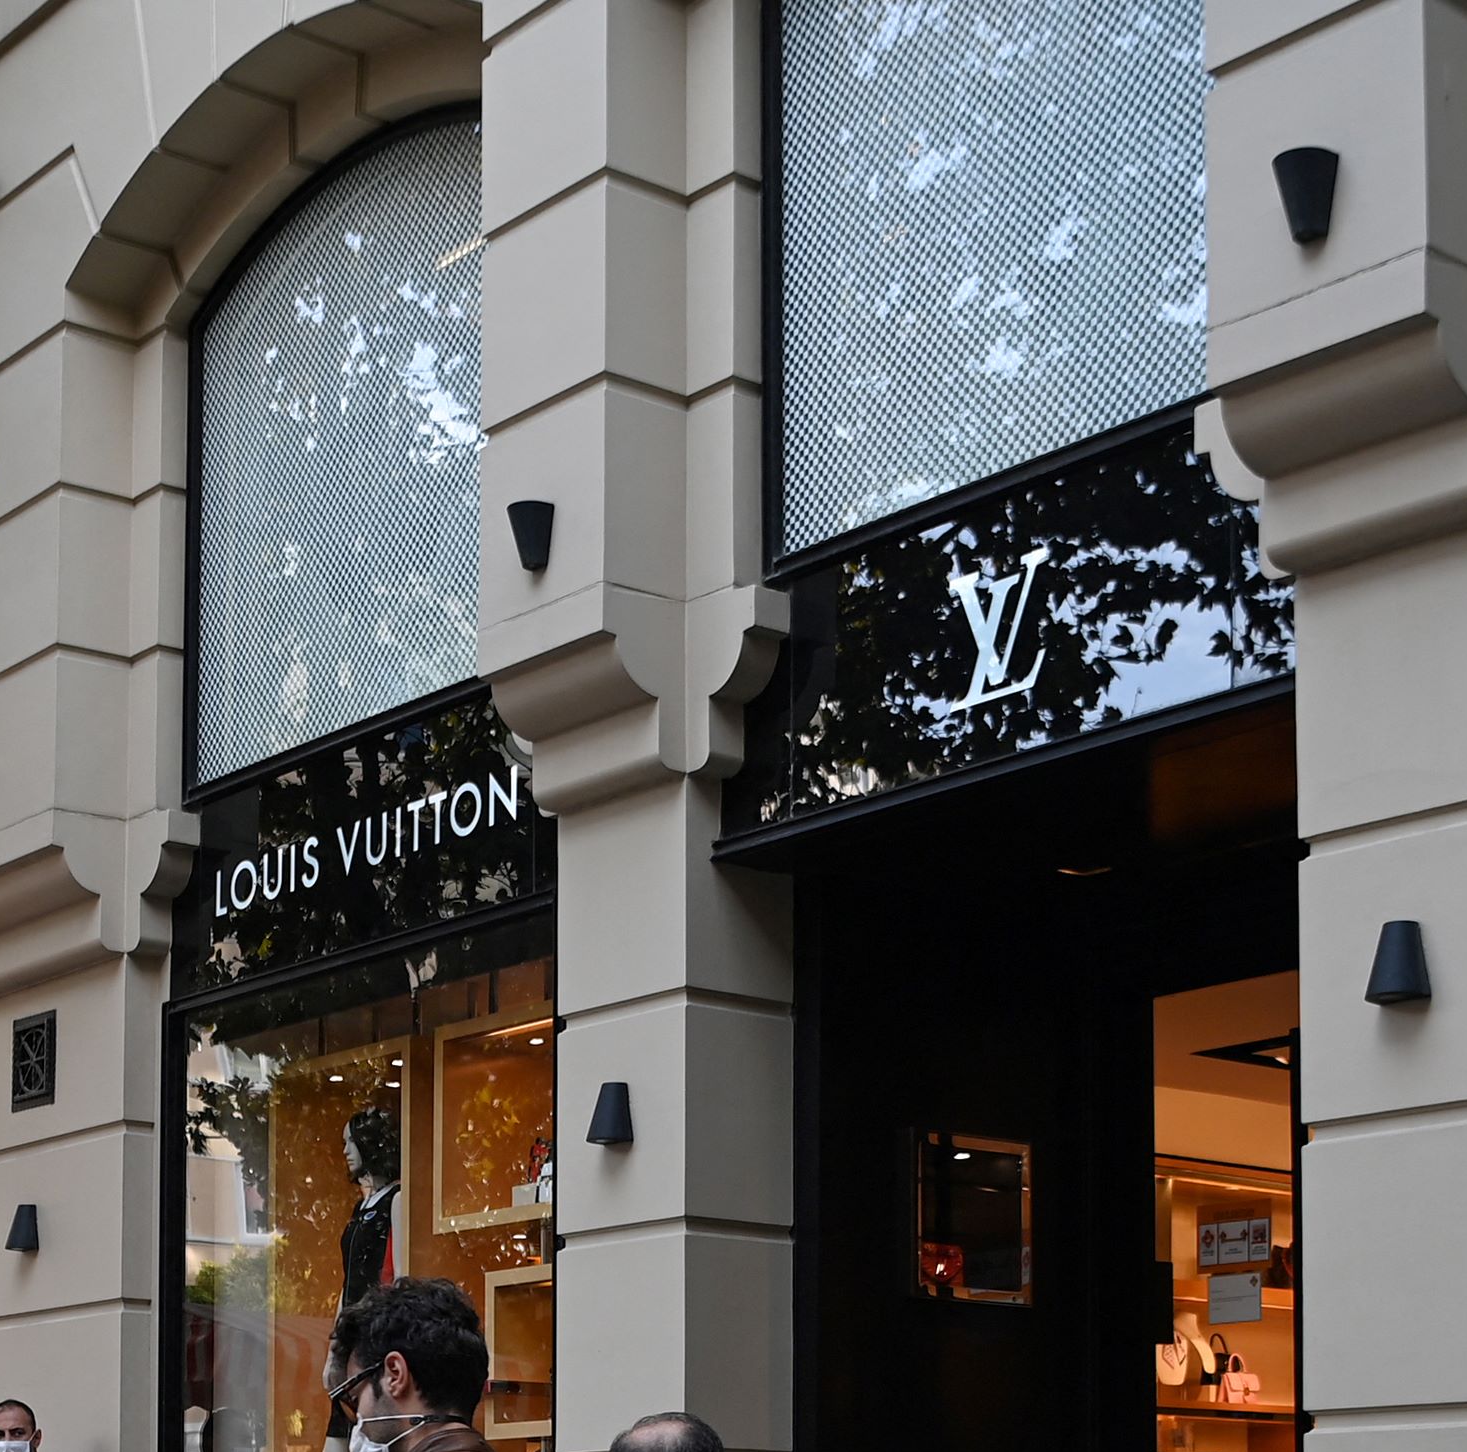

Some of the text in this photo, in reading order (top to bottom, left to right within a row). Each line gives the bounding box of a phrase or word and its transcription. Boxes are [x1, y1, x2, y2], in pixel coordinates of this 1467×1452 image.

[949, 547, 1050, 713] LV
[215, 764, 518, 918] LOUIS VUITTON
